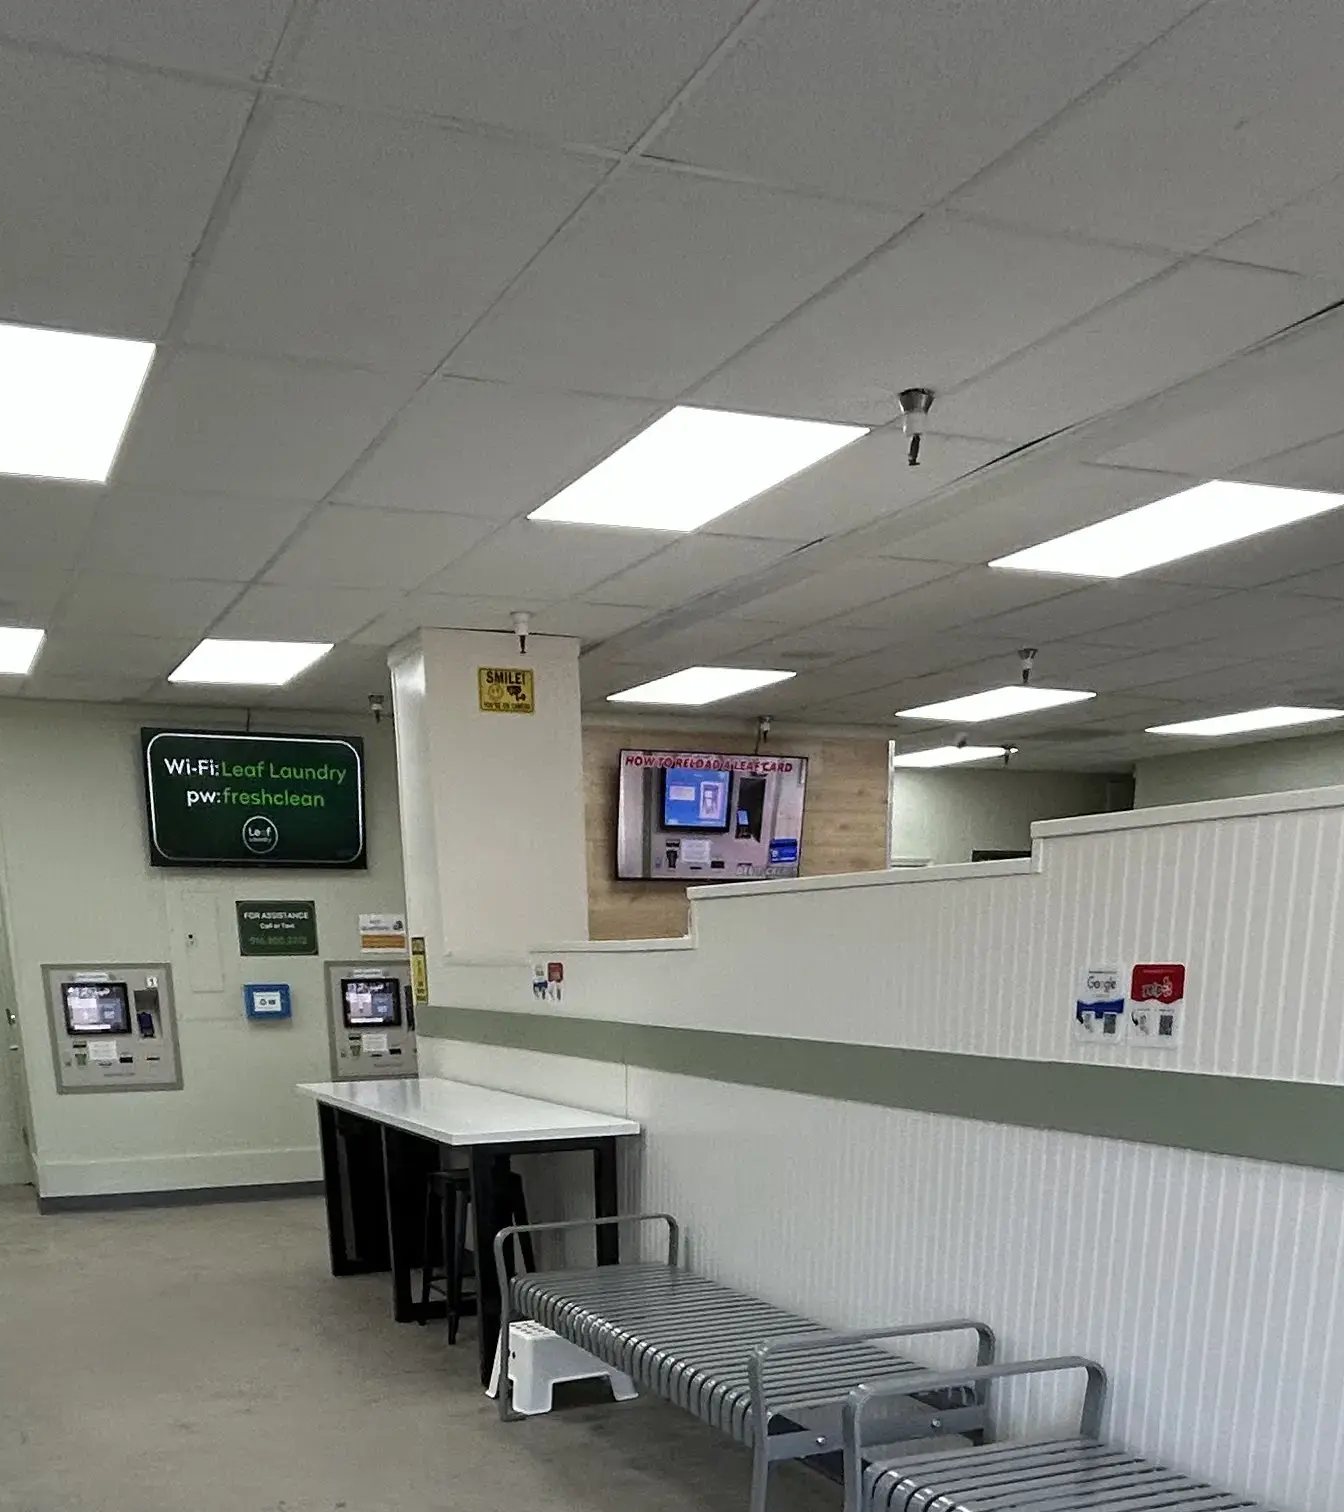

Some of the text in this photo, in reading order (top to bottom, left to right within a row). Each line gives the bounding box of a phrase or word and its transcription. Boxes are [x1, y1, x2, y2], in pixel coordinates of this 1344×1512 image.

[486, 670, 526, 685] SMILE!
[221, 761, 265, 778] Leaf
[269, 762, 347, 785] Laundry
[625, 756, 655, 767] HOW
[656, 757, 673, 768] TO
[674, 758, 721, 770] RELOAD
[762, 762, 793, 773] CARD
[222, 787, 325, 808] freshclean
